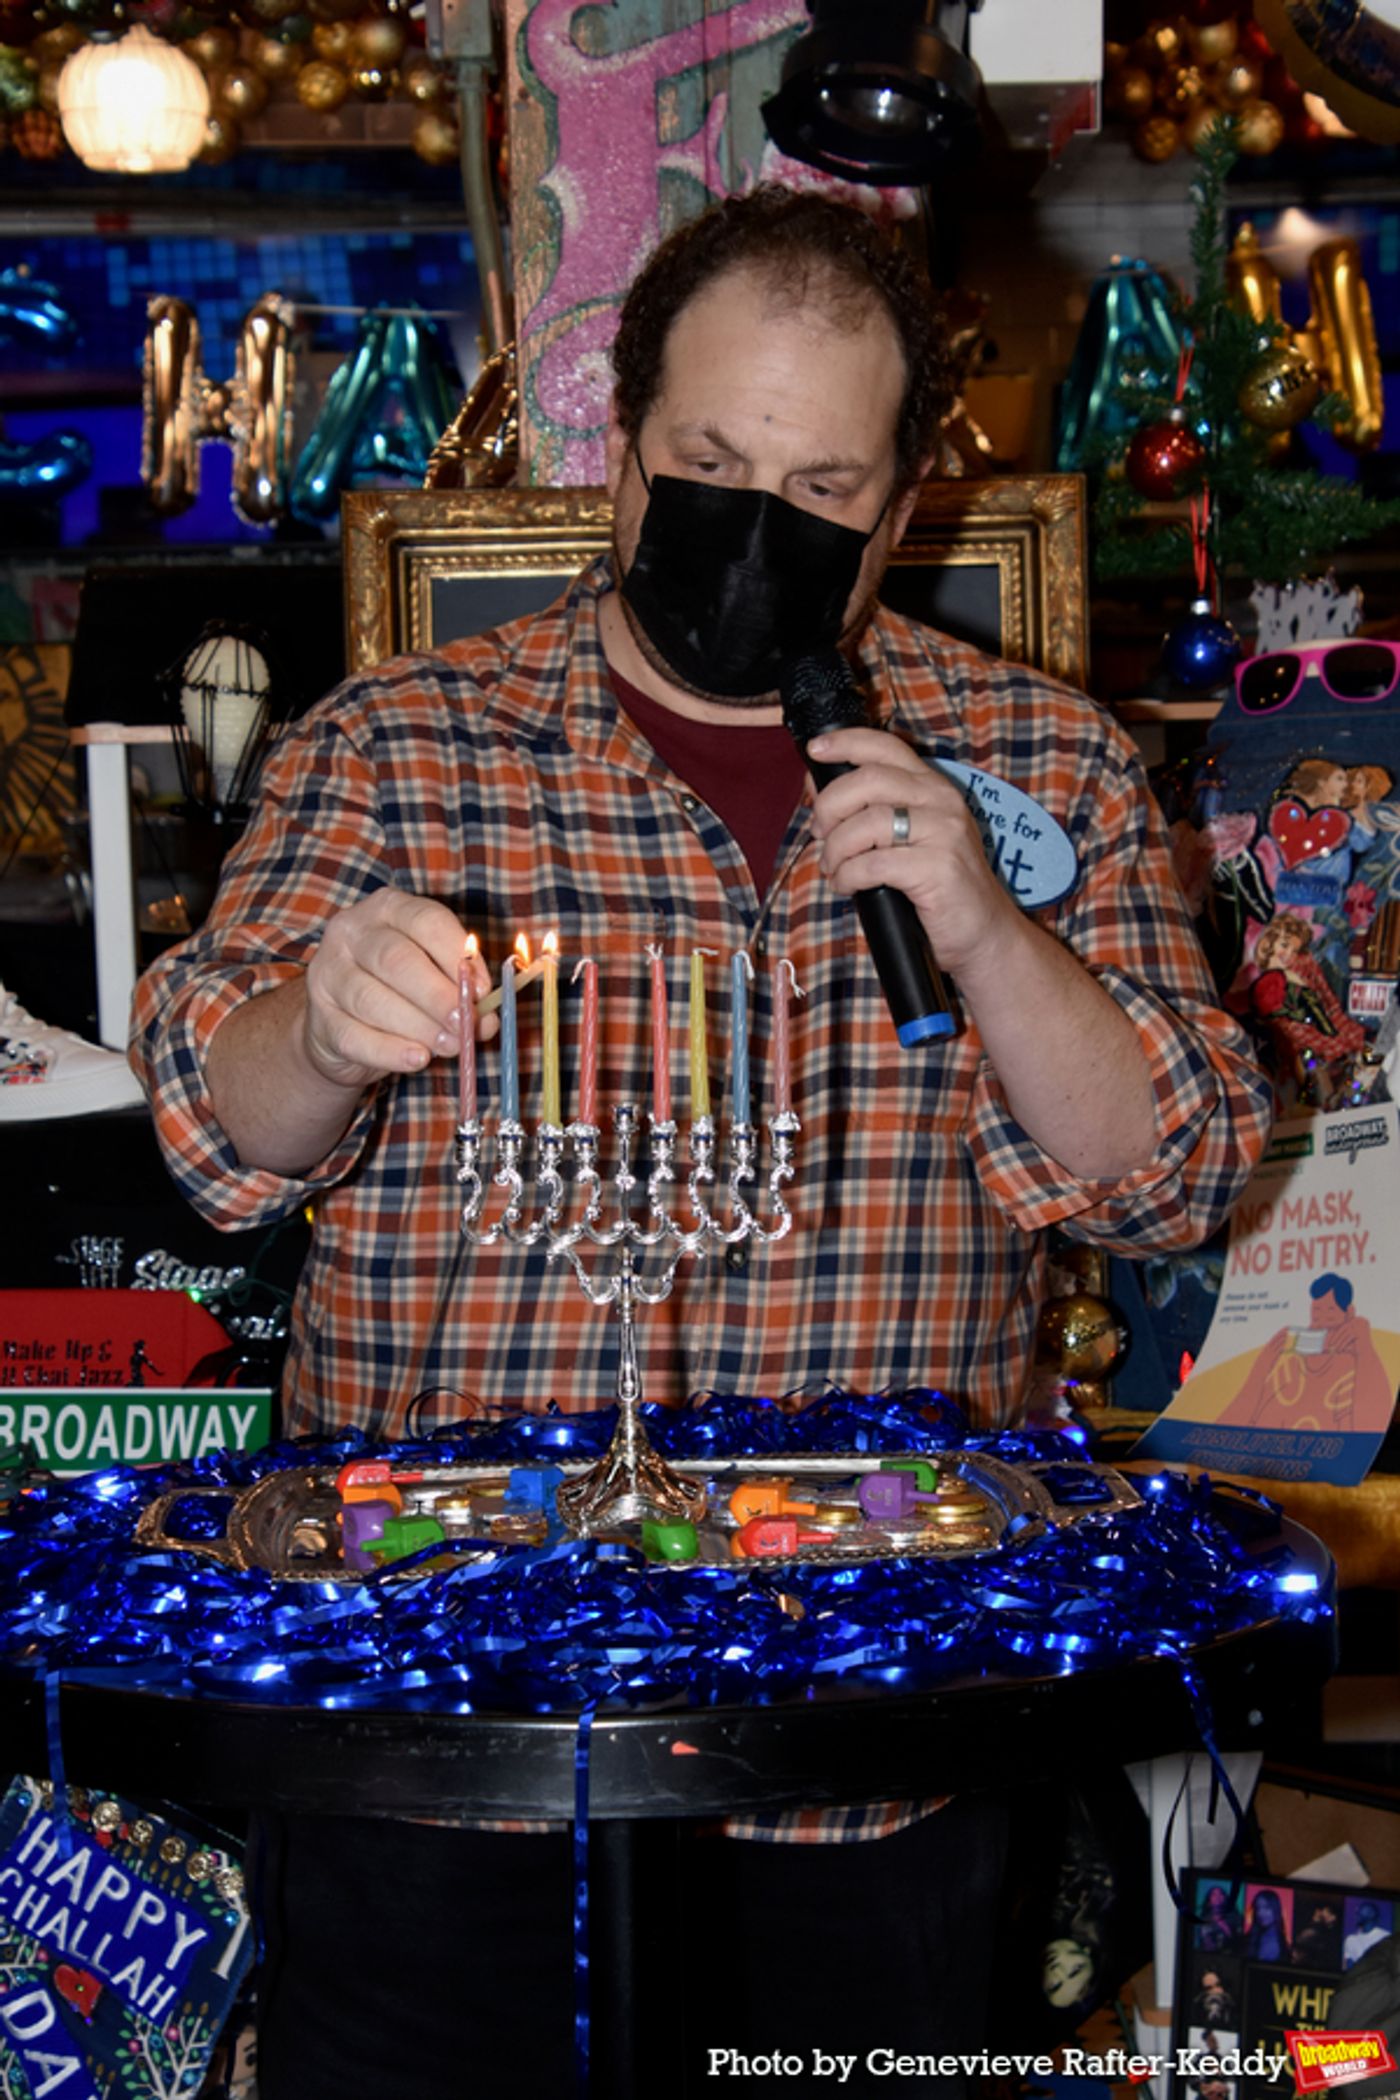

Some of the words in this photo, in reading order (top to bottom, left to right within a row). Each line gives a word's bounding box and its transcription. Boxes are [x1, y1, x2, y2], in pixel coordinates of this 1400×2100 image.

[1013, 812, 1043, 841] for
[1234, 1202, 1275, 1237] NO
[1280, 1189, 1362, 1231] MASK,
[1230, 1242, 1272, 1277] NO
[1278, 1230, 1376, 1273] ENTRY.
[17, 1817, 208, 1970] HAPPY
